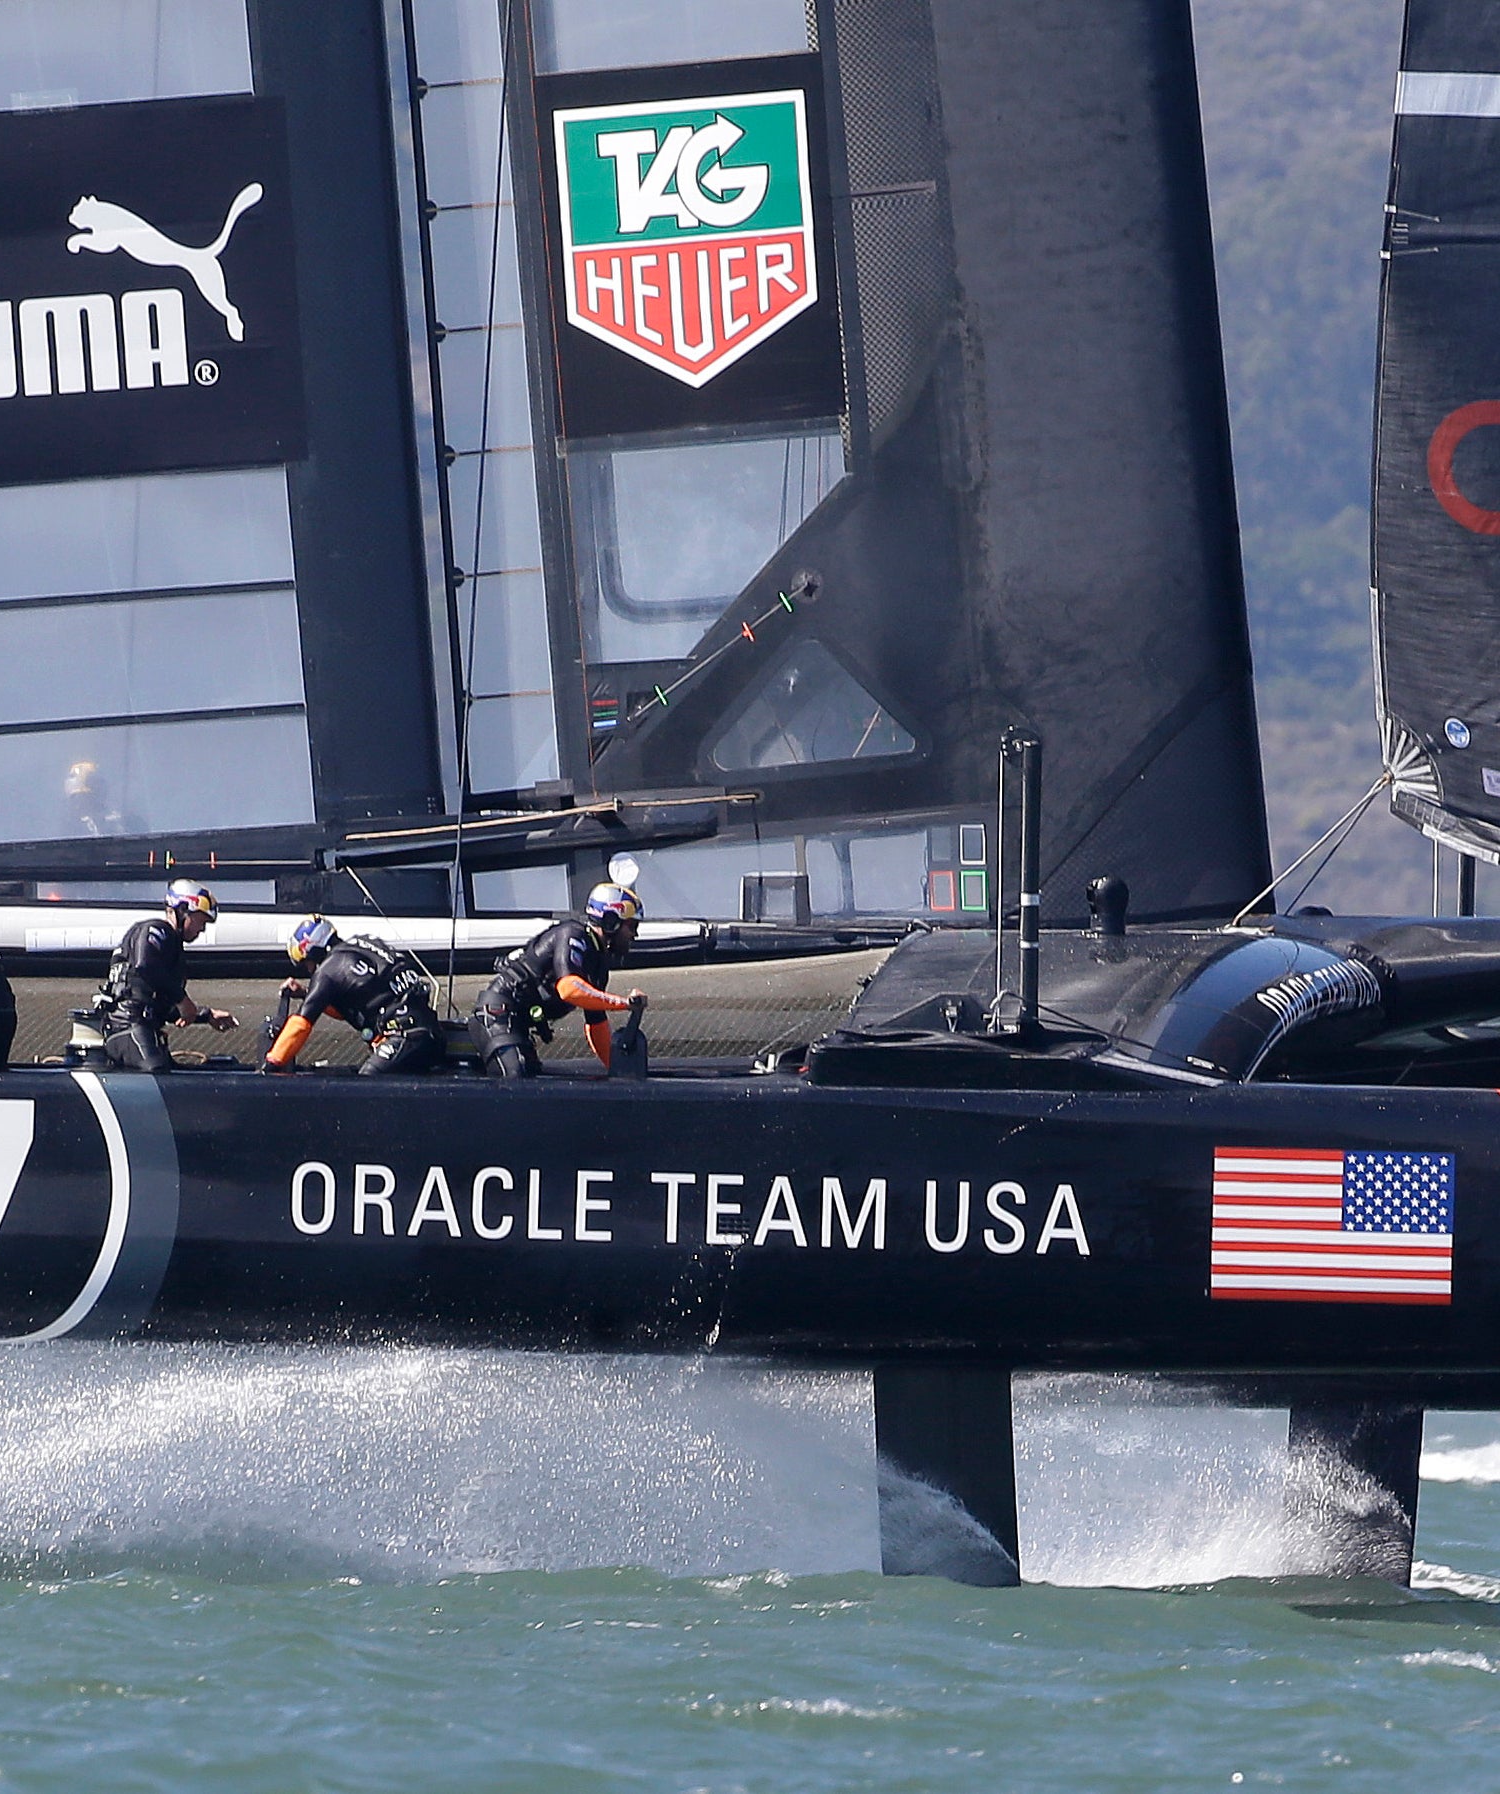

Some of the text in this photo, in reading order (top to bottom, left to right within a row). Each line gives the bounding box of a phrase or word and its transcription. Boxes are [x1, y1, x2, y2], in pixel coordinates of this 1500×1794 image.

[597, 113, 769, 234] TAG
[585, 243, 798, 362] HEUER
[291, 1161, 1091, 1256] ORACLE TEAM USA
